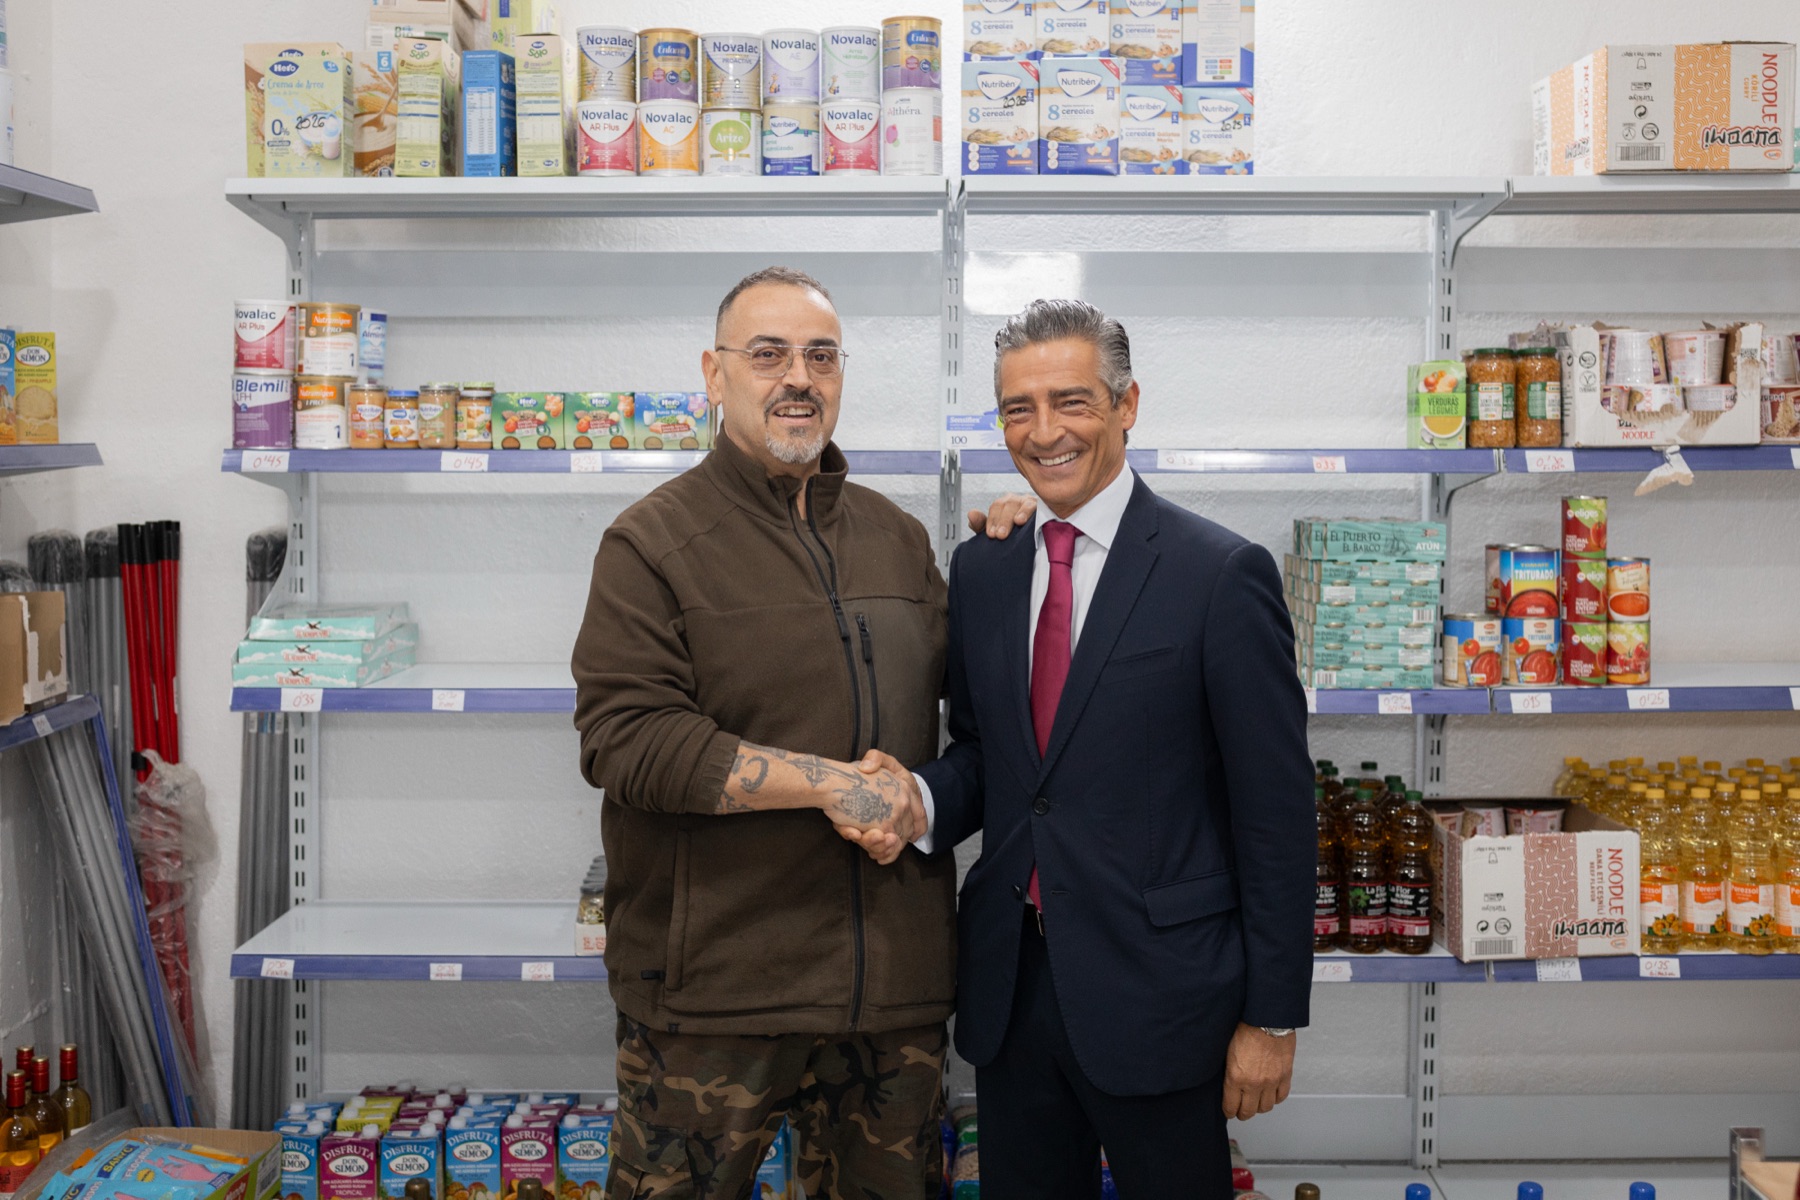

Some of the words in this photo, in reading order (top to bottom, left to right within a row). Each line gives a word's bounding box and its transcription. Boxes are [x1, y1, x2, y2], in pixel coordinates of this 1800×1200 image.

[970, 20, 982, 35] 8
[1044, 18, 1054, 32] 8
[1112, 24, 1124, 38] 8
[586, 34, 634, 48] Novalac
[770, 38, 816, 51] Novalac
[831, 34, 877, 46] Novalac
[712, 42, 758, 54] Novalac
[274, 63, 297, 72] Hero
[380, 58, 388, 67] 6
[606, 70, 614, 81] 2
[268, 80, 294, 89] Crema
[296, 80, 304, 89] de
[981, 80, 1016, 88] Nutribén
[1061, 78, 1096, 86] Nutribén
[1762, 52, 1778, 124] NOODLE
[1048, 104, 1060, 121] 8
[1202, 104, 1234, 114] Nutribén
[582, 109, 628, 121] Novalac
[645, 112, 692, 124] Novalac
[827, 109, 874, 121] Novalac
[968, 107, 981, 124] 8
[295, 114, 326, 130] 2026
[590, 123, 600, 132] AR
[603, 123, 620, 132] Plus
[835, 123, 846, 132] AR
[848, 123, 865, 132] Plus
[662, 126, 675, 134] AC
[716, 132, 744, 144] Arize
[1190, 130, 1200, 144] 8
[250, 322, 266, 330] Plus
[16, 336, 55, 350] DISFRUTA
[20, 354, 47, 362] SIMON
[350, 353, 354, 367] 1
[236, 379, 284, 392] Blemil
[1428, 397, 1459, 406] VERDURAS
[1428, 406, 1459, 415] LEGUMES
[334, 425, 340, 439] 1
[1622, 430, 1656, 440] NOODLE
[951, 436, 968, 445] 100
[1344, 531, 1381, 542] PUERTO
[1353, 543, 1380, 552] BARCO
[1416, 540, 1440, 550] ATÚN
[1514, 569, 1554, 580] TRITURADO
[1608, 848, 1624, 916] NOODLE
[1366, 886, 1376, 894] La
[1396, 886, 1411, 894] Flor
[446, 1131, 498, 1146] DISFRUTA
[502, 1130, 553, 1145] DISFRUTA
[283, 1140, 315, 1157] FRUTA
[322, 1144, 374, 1161] DISFRUTA
[383, 1144, 434, 1160] DISFRUTA
[458, 1150, 489, 1158] SIMON
[514, 1150, 544, 1158] SIMON
[572, 1150, 602, 1158] SIMON
[334, 1165, 365, 1173] SIMON
[395, 1162, 426, 1172] SIMON
